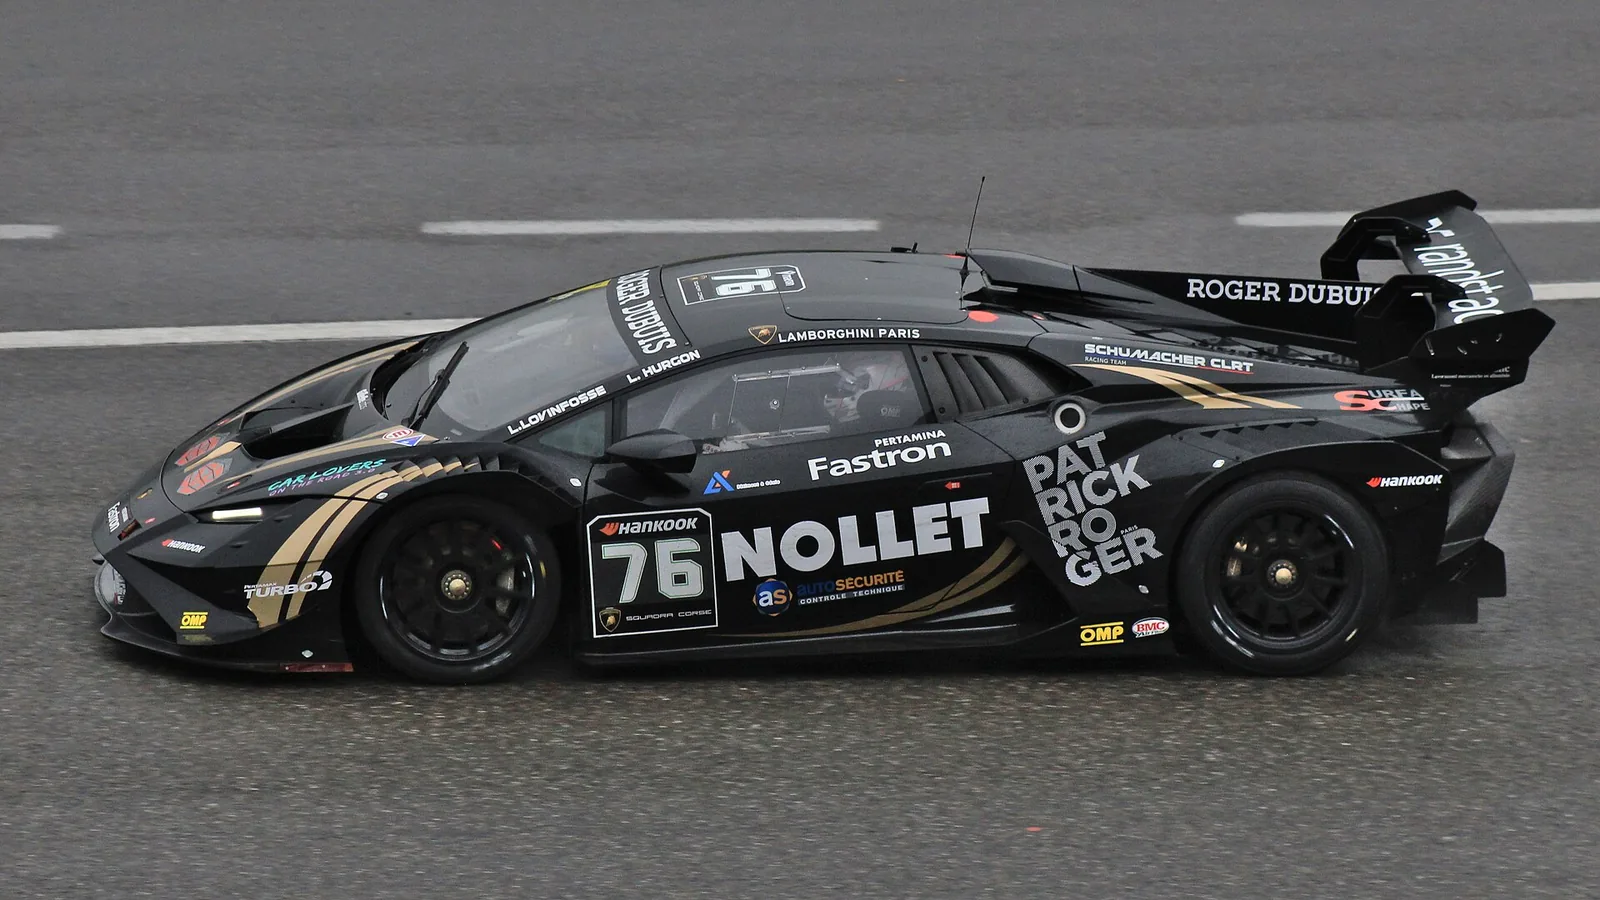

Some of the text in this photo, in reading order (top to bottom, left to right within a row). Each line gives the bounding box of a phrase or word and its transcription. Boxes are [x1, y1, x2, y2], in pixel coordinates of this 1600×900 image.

[711, 268, 777, 296] 76
[1186, 278, 1383, 306] ROGER DUBUI
[621, 299, 677, 355] DUBUIS
[778, 329, 921, 343] LAMBORGHINI PARIS
[626, 349, 701, 384] L. HURGON
[1084, 343, 1254, 372] SCHUMACHER CLRT
[1084, 356, 1127, 366] RACING TEAM
[874, 429, 946, 447] PERTAMINA
[807, 441, 952, 481] Fastron
[1022, 431, 1107, 494] PAT
[268, 459, 387, 492] CAR LOVERS
[269, 487, 287, 497] ON
[291, 480, 314, 490] THE
[317, 472, 351, 484] ROAD
[1035, 454, 1152, 527] RICK
[720, 496, 990, 582] NOLLET
[1047, 507, 1117, 558] RO
[1120, 524, 1138, 535] PARIS
[601, 537, 704, 604] 76
[1065, 527, 1164, 587] GER
[243, 581, 318, 599] TURBO
[800, 585, 903, 605] CONTROLE TECHNIQUE
[181, 614, 207, 627] OMP
[625, 609, 712, 621] SQUADRA CORSE
[1136, 621, 1165, 633] BMC
[1080, 625, 1124, 642] OMP
